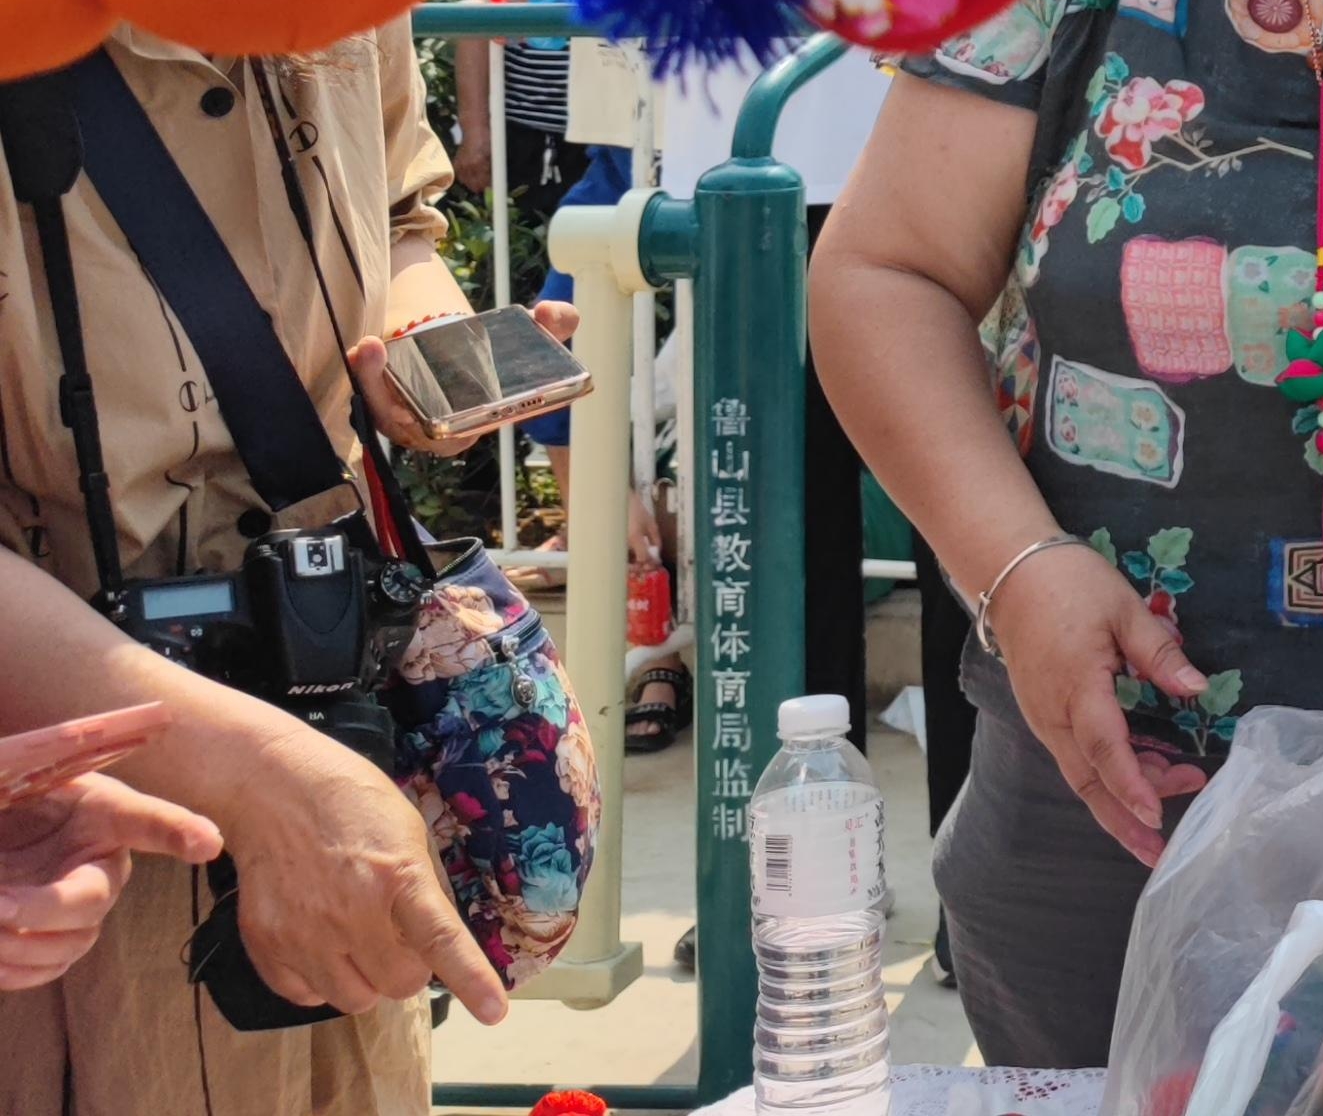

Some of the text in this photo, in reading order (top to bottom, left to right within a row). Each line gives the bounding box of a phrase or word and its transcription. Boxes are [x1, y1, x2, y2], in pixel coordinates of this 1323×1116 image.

[287, 681, 355, 696] Nikon
[711, 397, 752, 843] 鲁山县教育体育局监制
